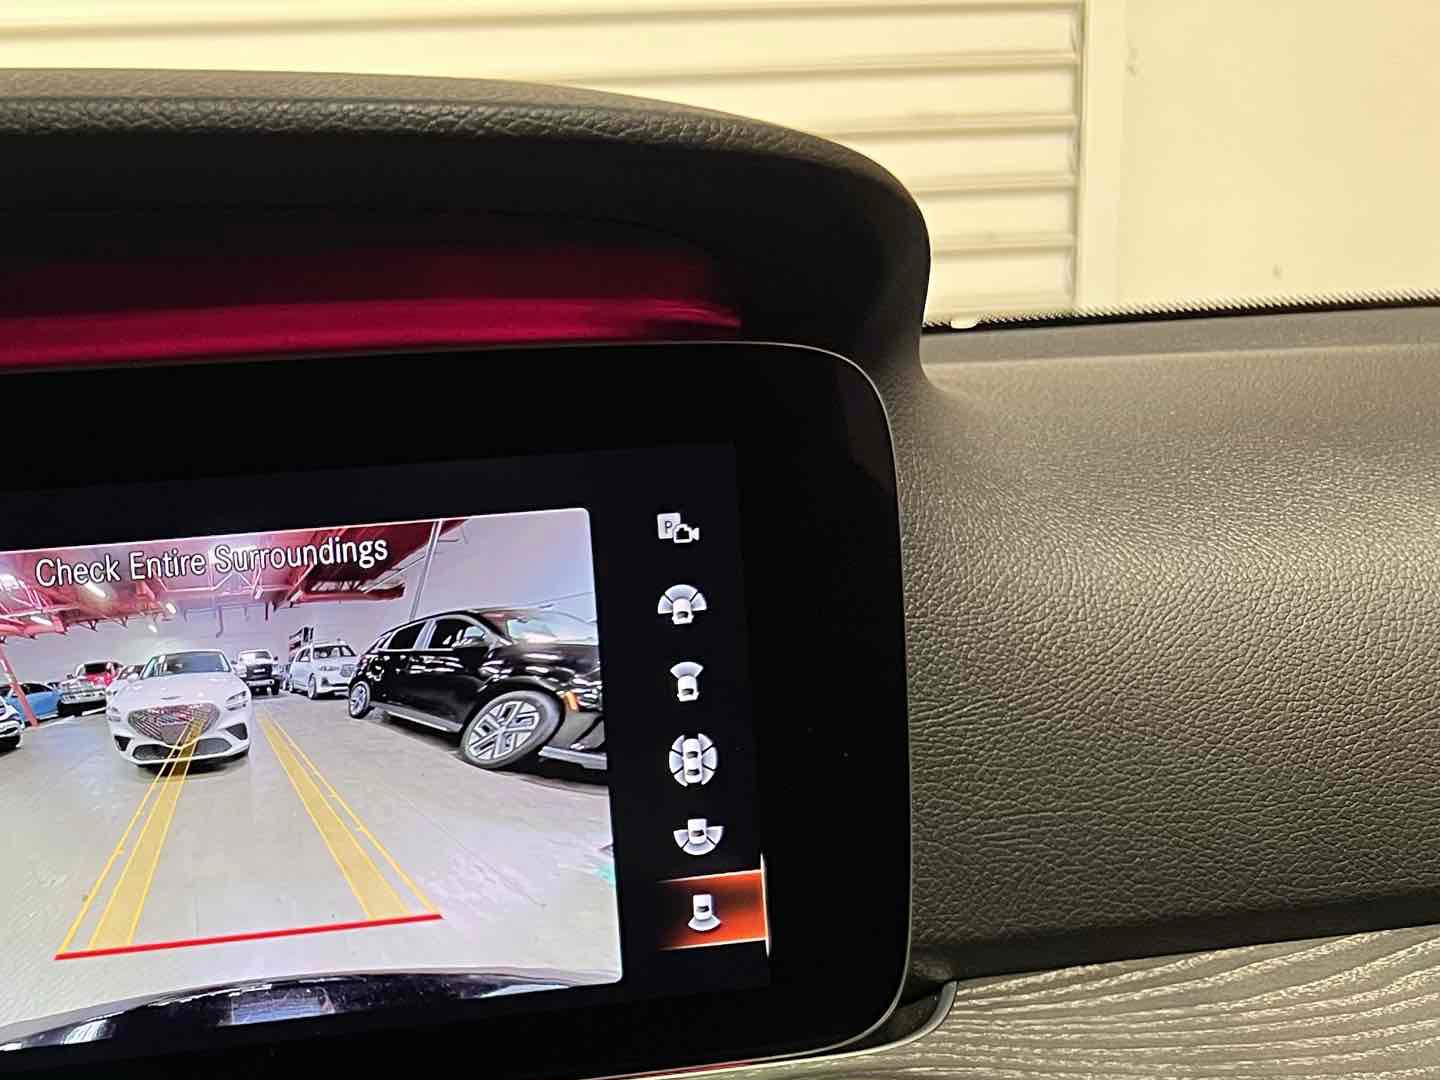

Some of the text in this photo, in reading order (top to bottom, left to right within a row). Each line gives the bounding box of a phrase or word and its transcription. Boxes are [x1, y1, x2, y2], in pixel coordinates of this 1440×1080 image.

[35, 537, 388, 587] Check Entire Surroundings
